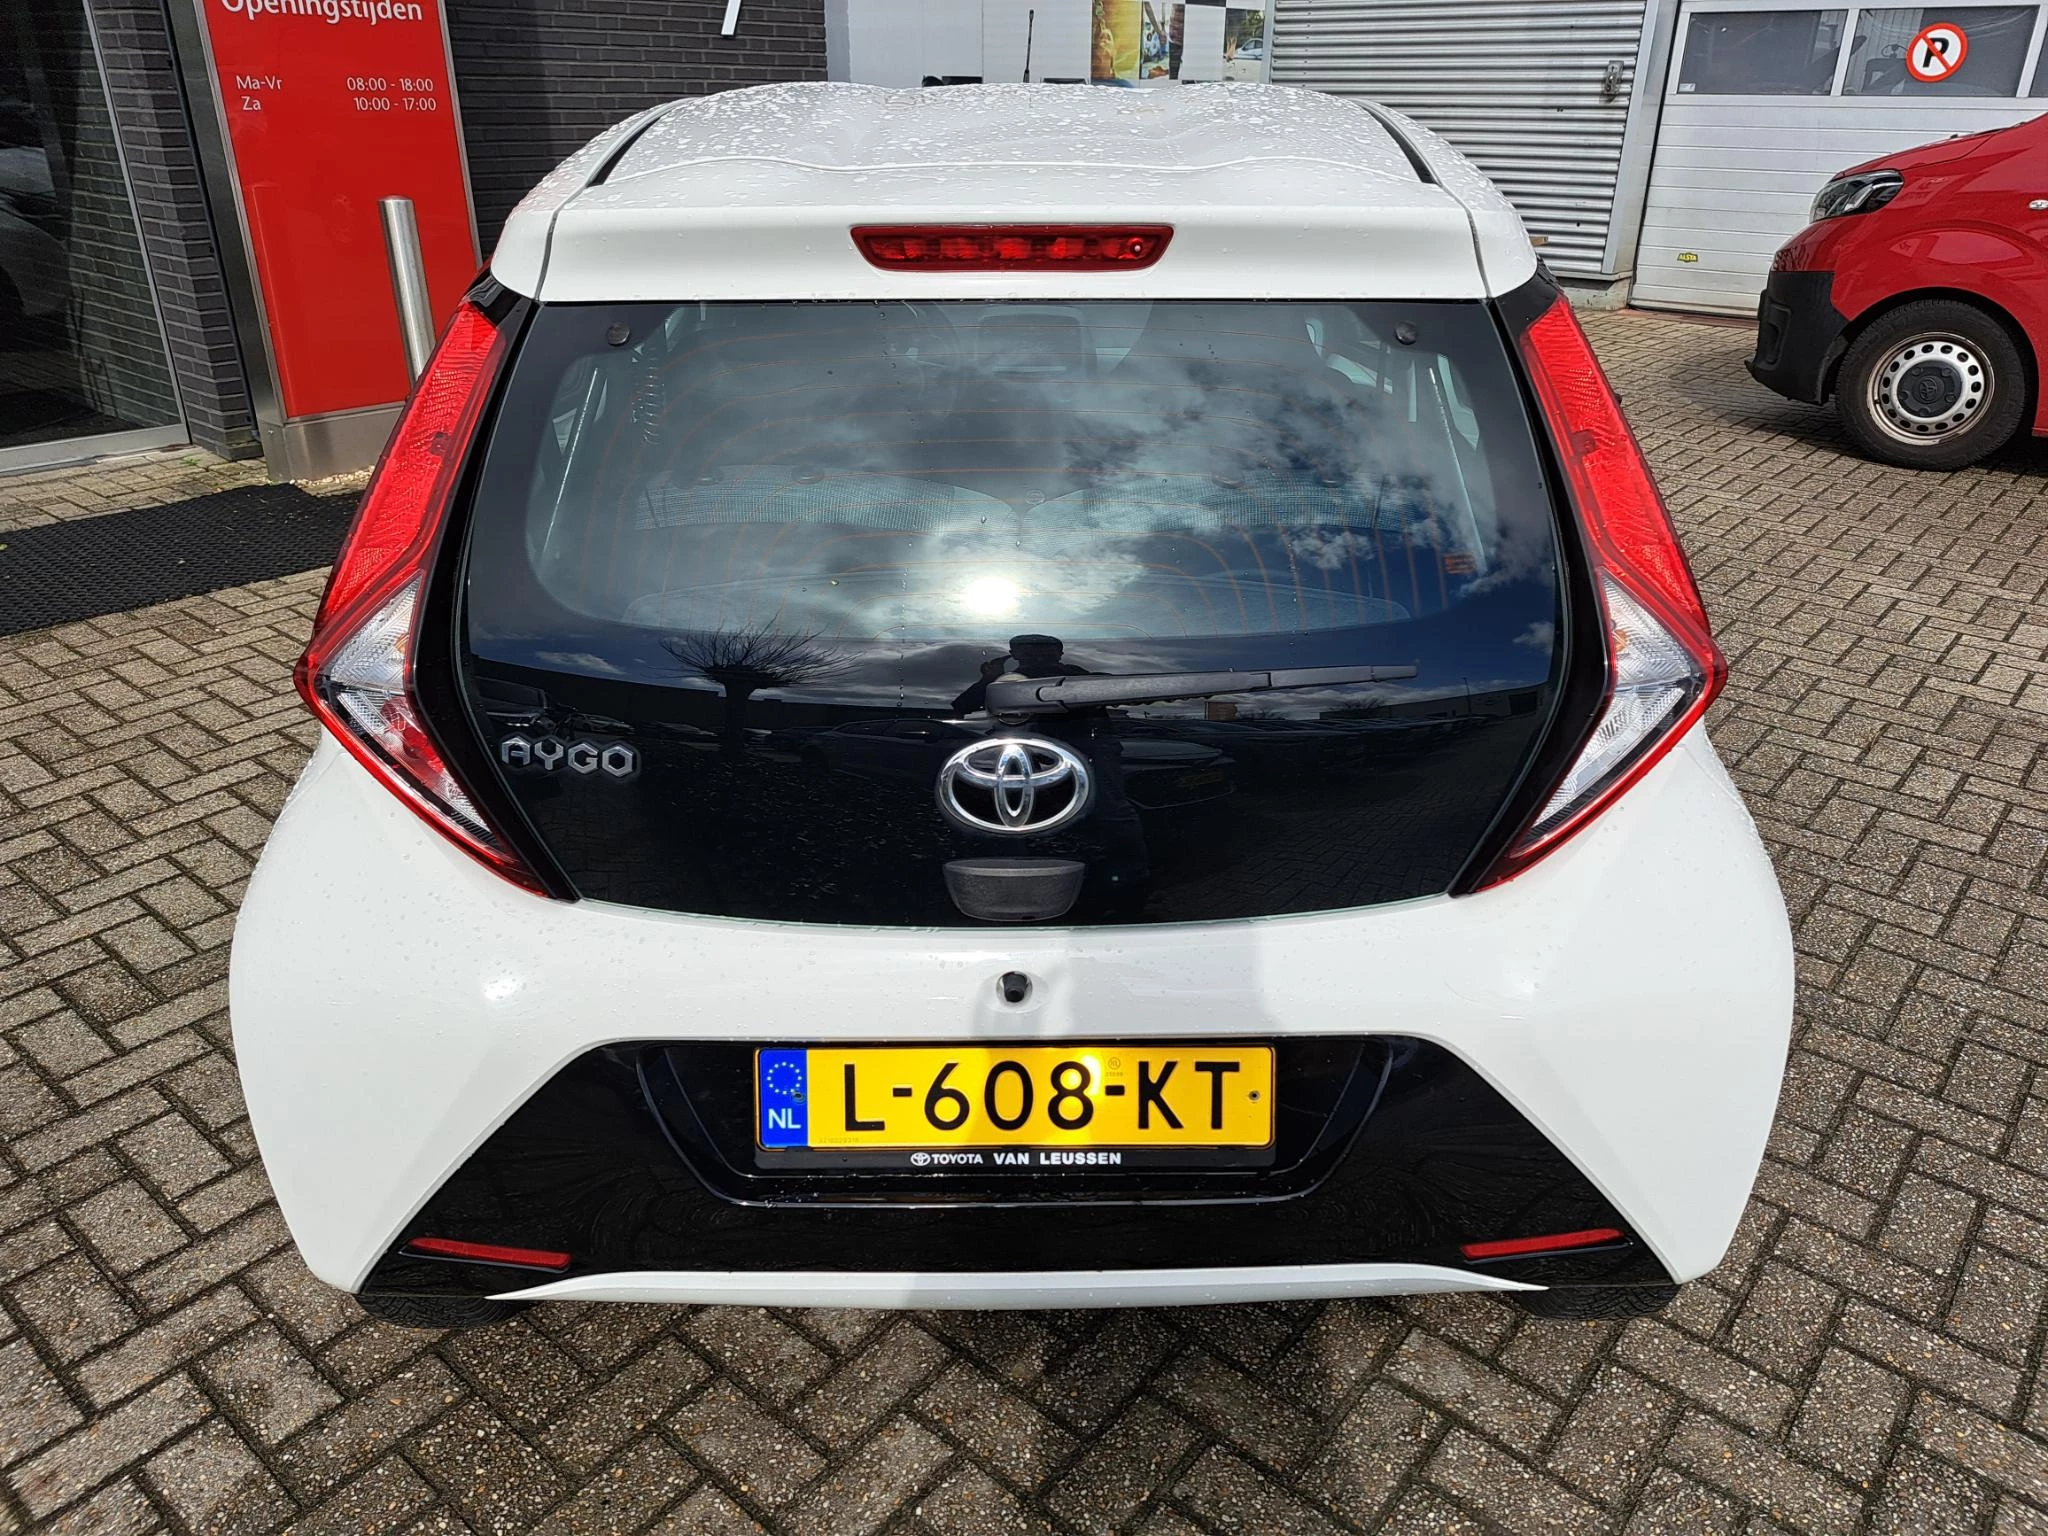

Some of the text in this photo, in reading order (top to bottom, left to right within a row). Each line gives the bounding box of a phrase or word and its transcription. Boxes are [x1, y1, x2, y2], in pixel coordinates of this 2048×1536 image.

[221, 0, 423, 26] Openingstijden
[235, 75, 283, 91] Ma-Vr
[346, 77, 387, 92] 08:00
[399, 77, 434, 92] 18:00
[240, 96, 262, 111] Za
[353, 97, 391, 111] 10:00
[402, 97, 437, 111] 17:00
[501, 735, 634, 778] AYGO
[843, 1060, 1241, 1132] L-608-KT
[768, 1108, 801, 1129] NL
[931, 1152, 1121, 1165] TOYOTA VAN LEUSSEN
